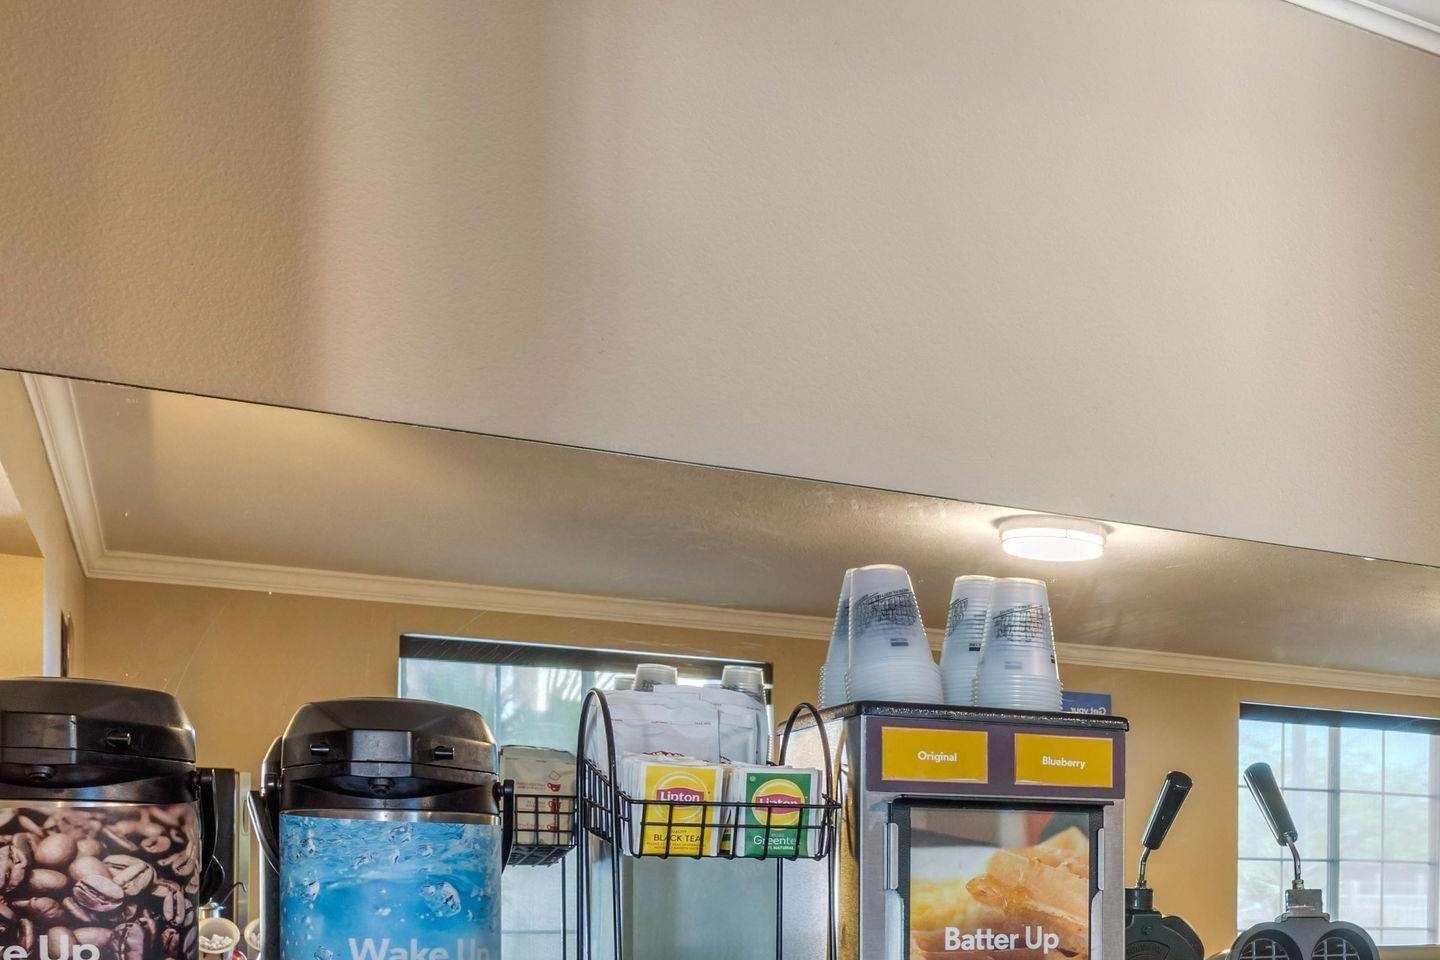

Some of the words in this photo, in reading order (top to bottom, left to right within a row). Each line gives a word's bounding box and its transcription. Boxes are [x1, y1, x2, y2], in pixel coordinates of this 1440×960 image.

[917, 750, 958, 763] Original
[1042, 755, 1087, 770] Blueberry
[660, 790, 700, 802] Lipton
[944, 926, 1019, 951] Batter
[1025, 925, 1059, 955] Up
